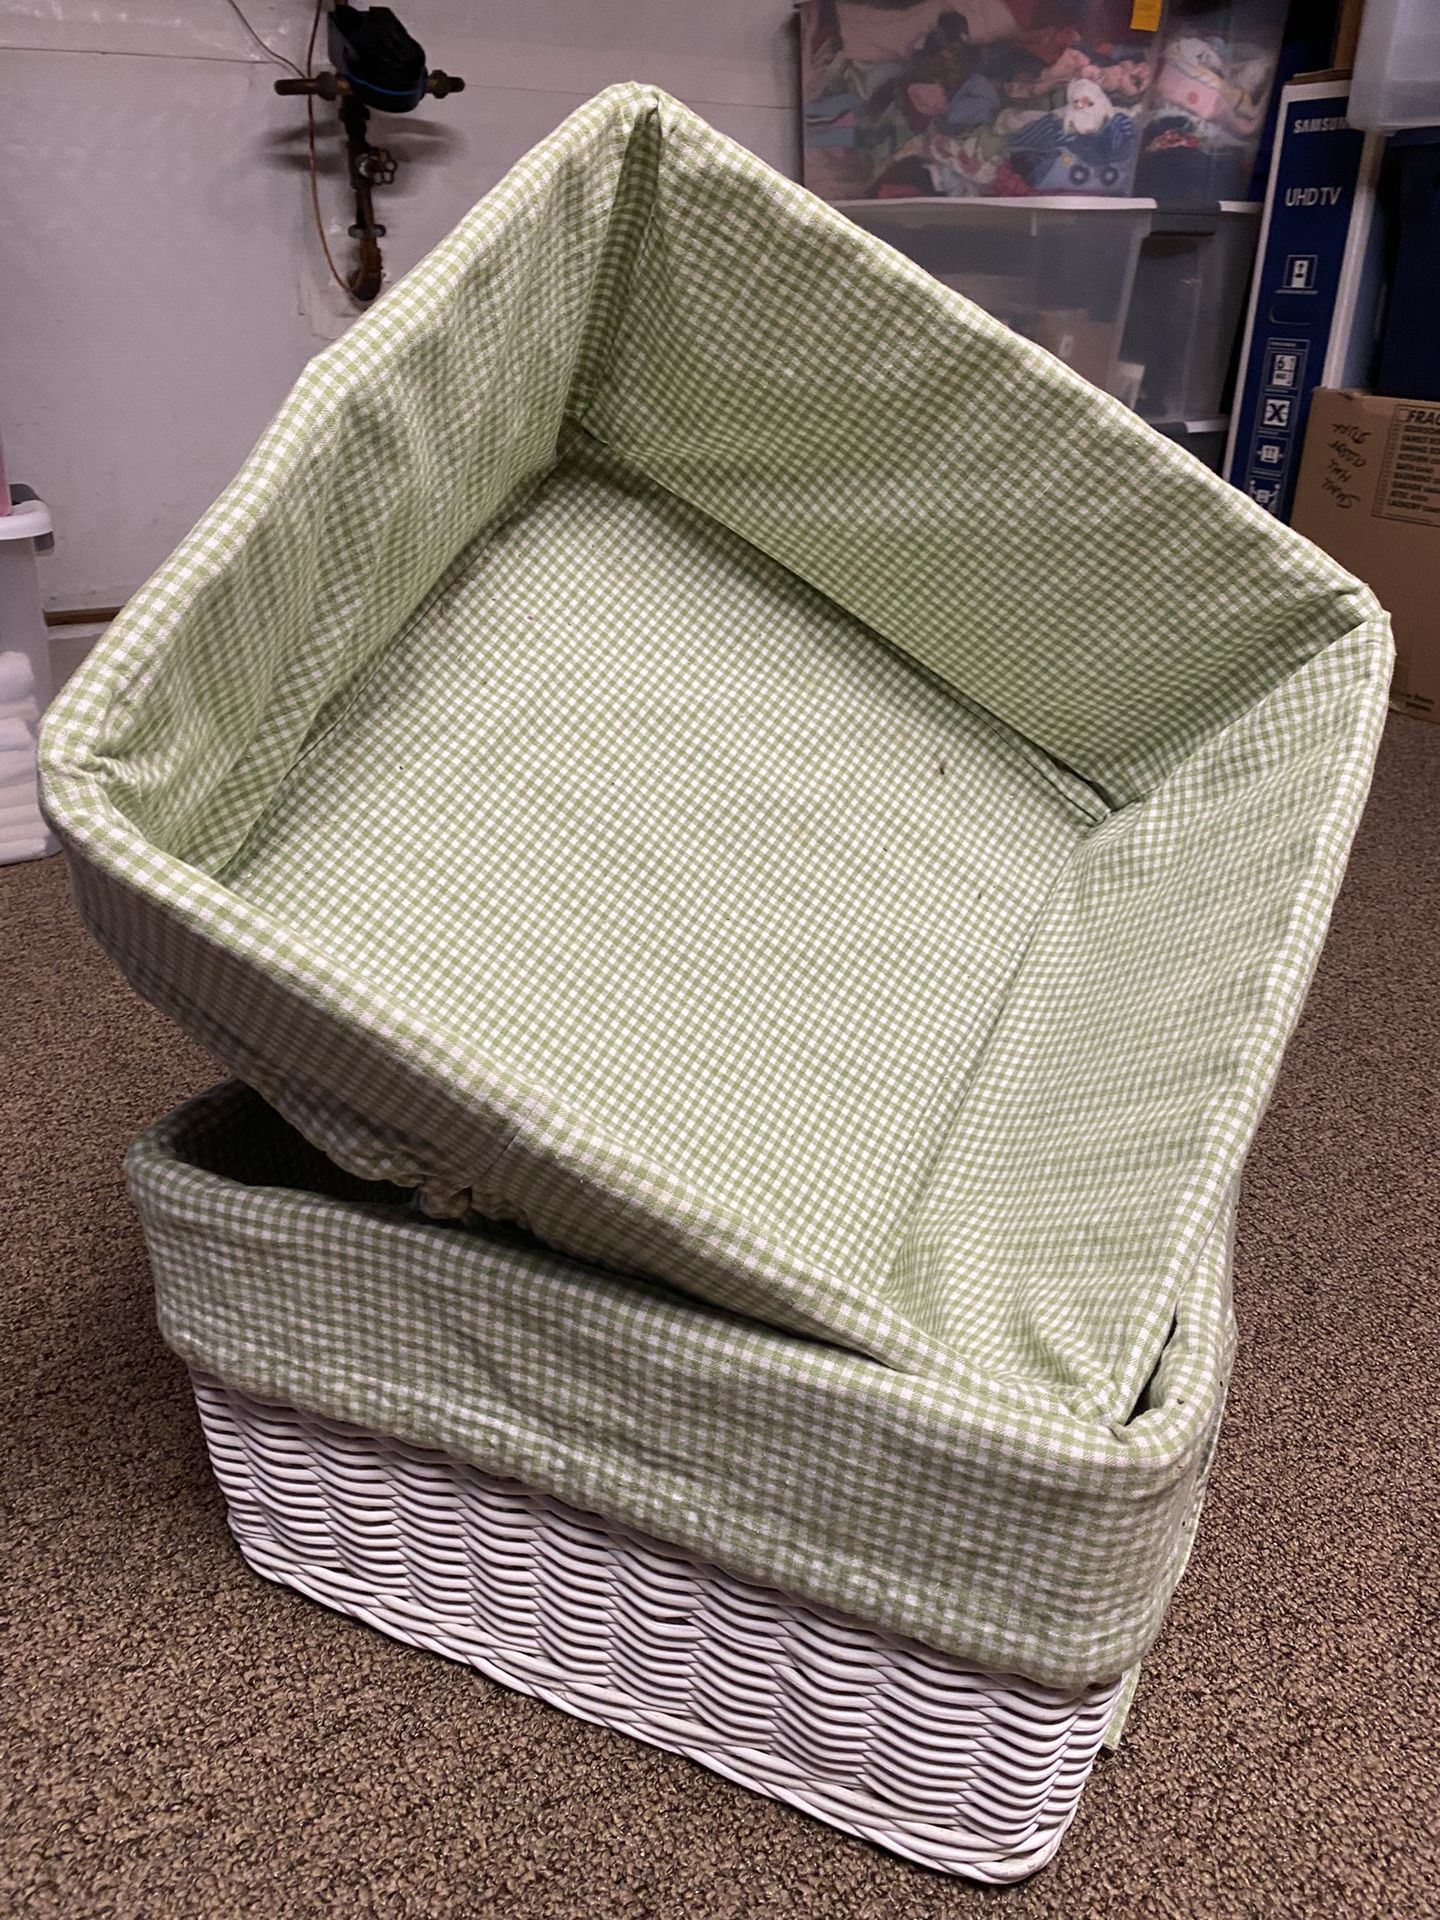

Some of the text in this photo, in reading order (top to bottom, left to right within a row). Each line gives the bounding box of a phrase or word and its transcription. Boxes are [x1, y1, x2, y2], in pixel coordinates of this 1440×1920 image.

[1293, 117, 1348, 133] SAMSUN
[1286, 186, 1342, 206] UHD TV
